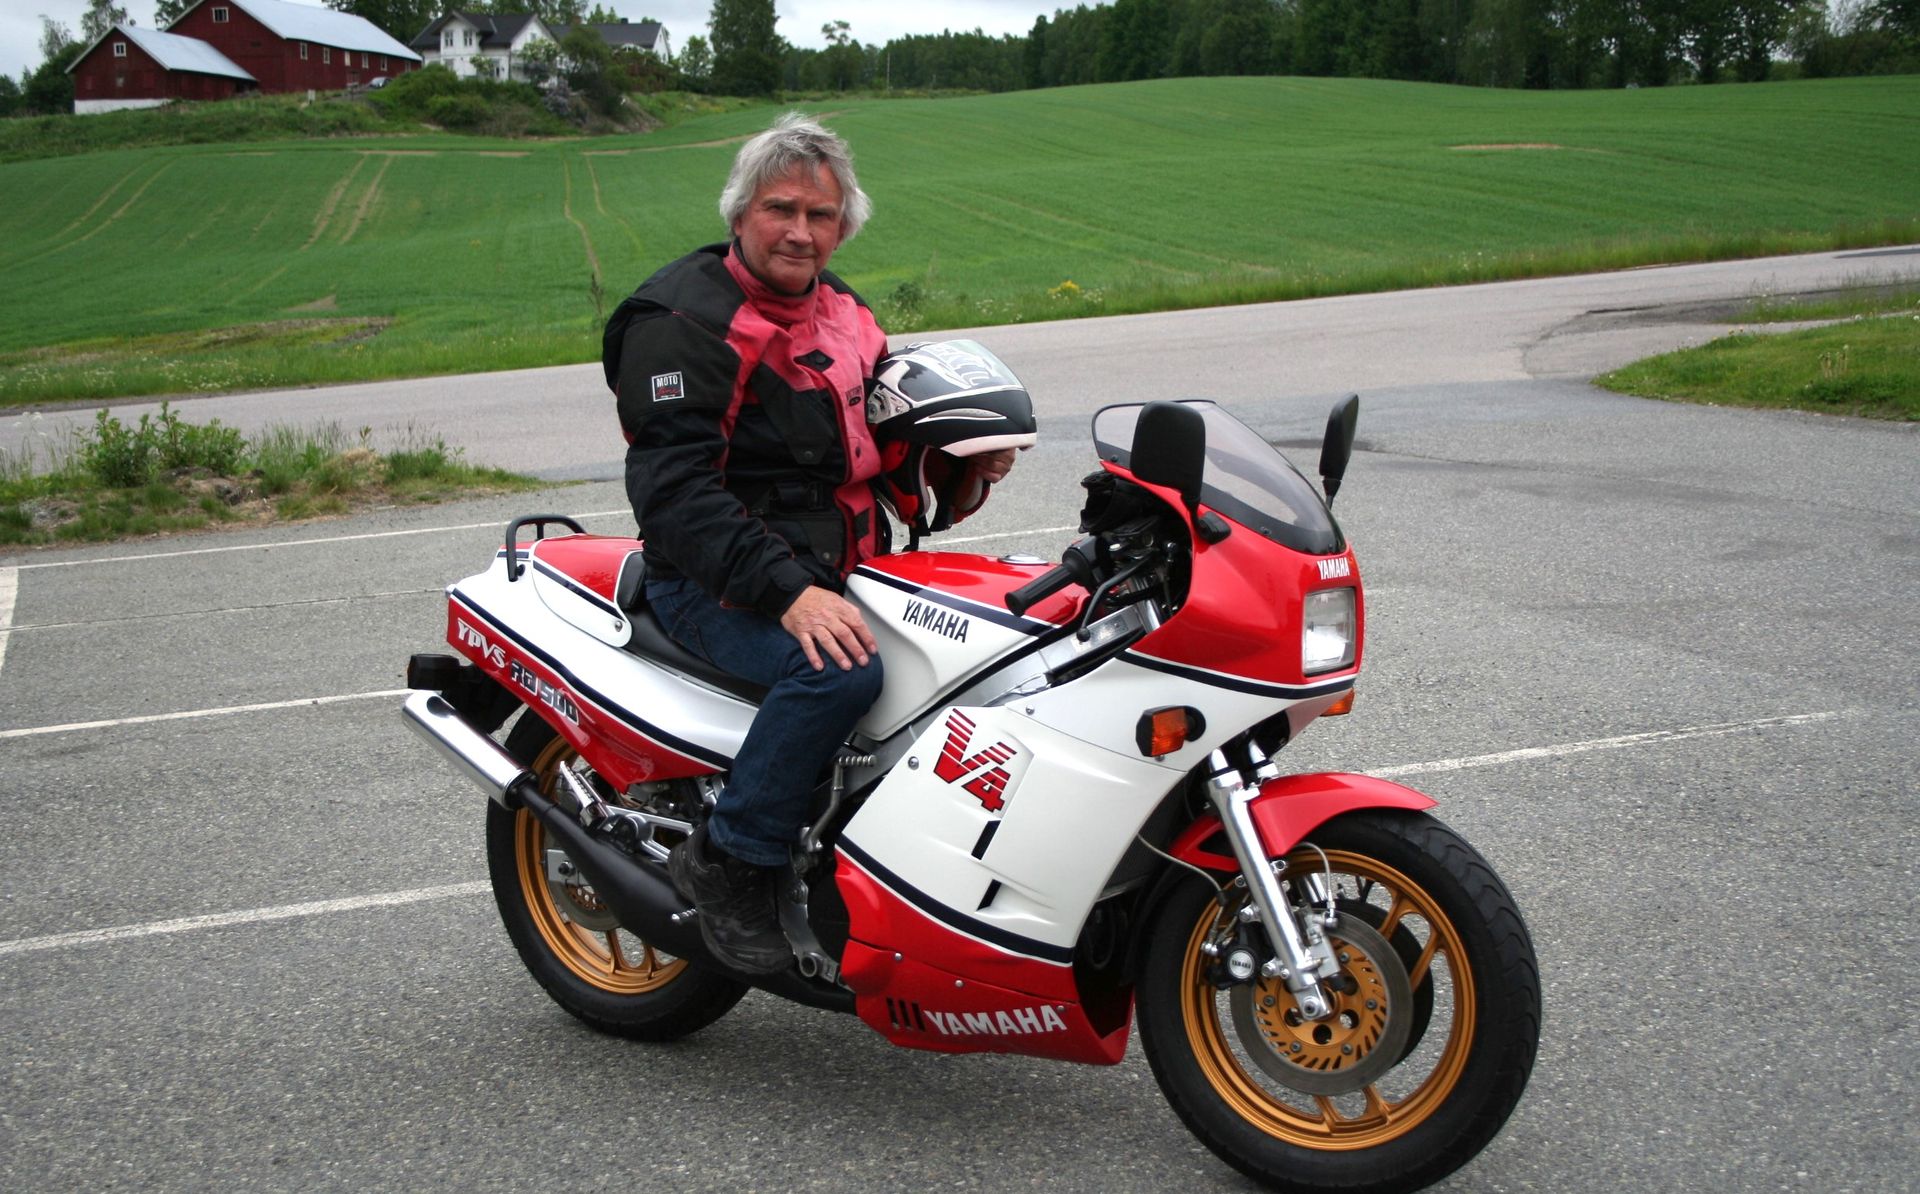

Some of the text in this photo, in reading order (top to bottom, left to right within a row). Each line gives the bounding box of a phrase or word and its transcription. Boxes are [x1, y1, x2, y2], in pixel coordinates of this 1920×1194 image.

[656, 374, 678, 388] MOTO
[1316, 557, 1350, 580] YAMAHA
[902, 599, 970, 644] YAMAHA
[457, 619, 506, 669] YPVS
[933, 708, 1018, 813] V4
[924, 1004, 1068, 1036] YAMAHA
